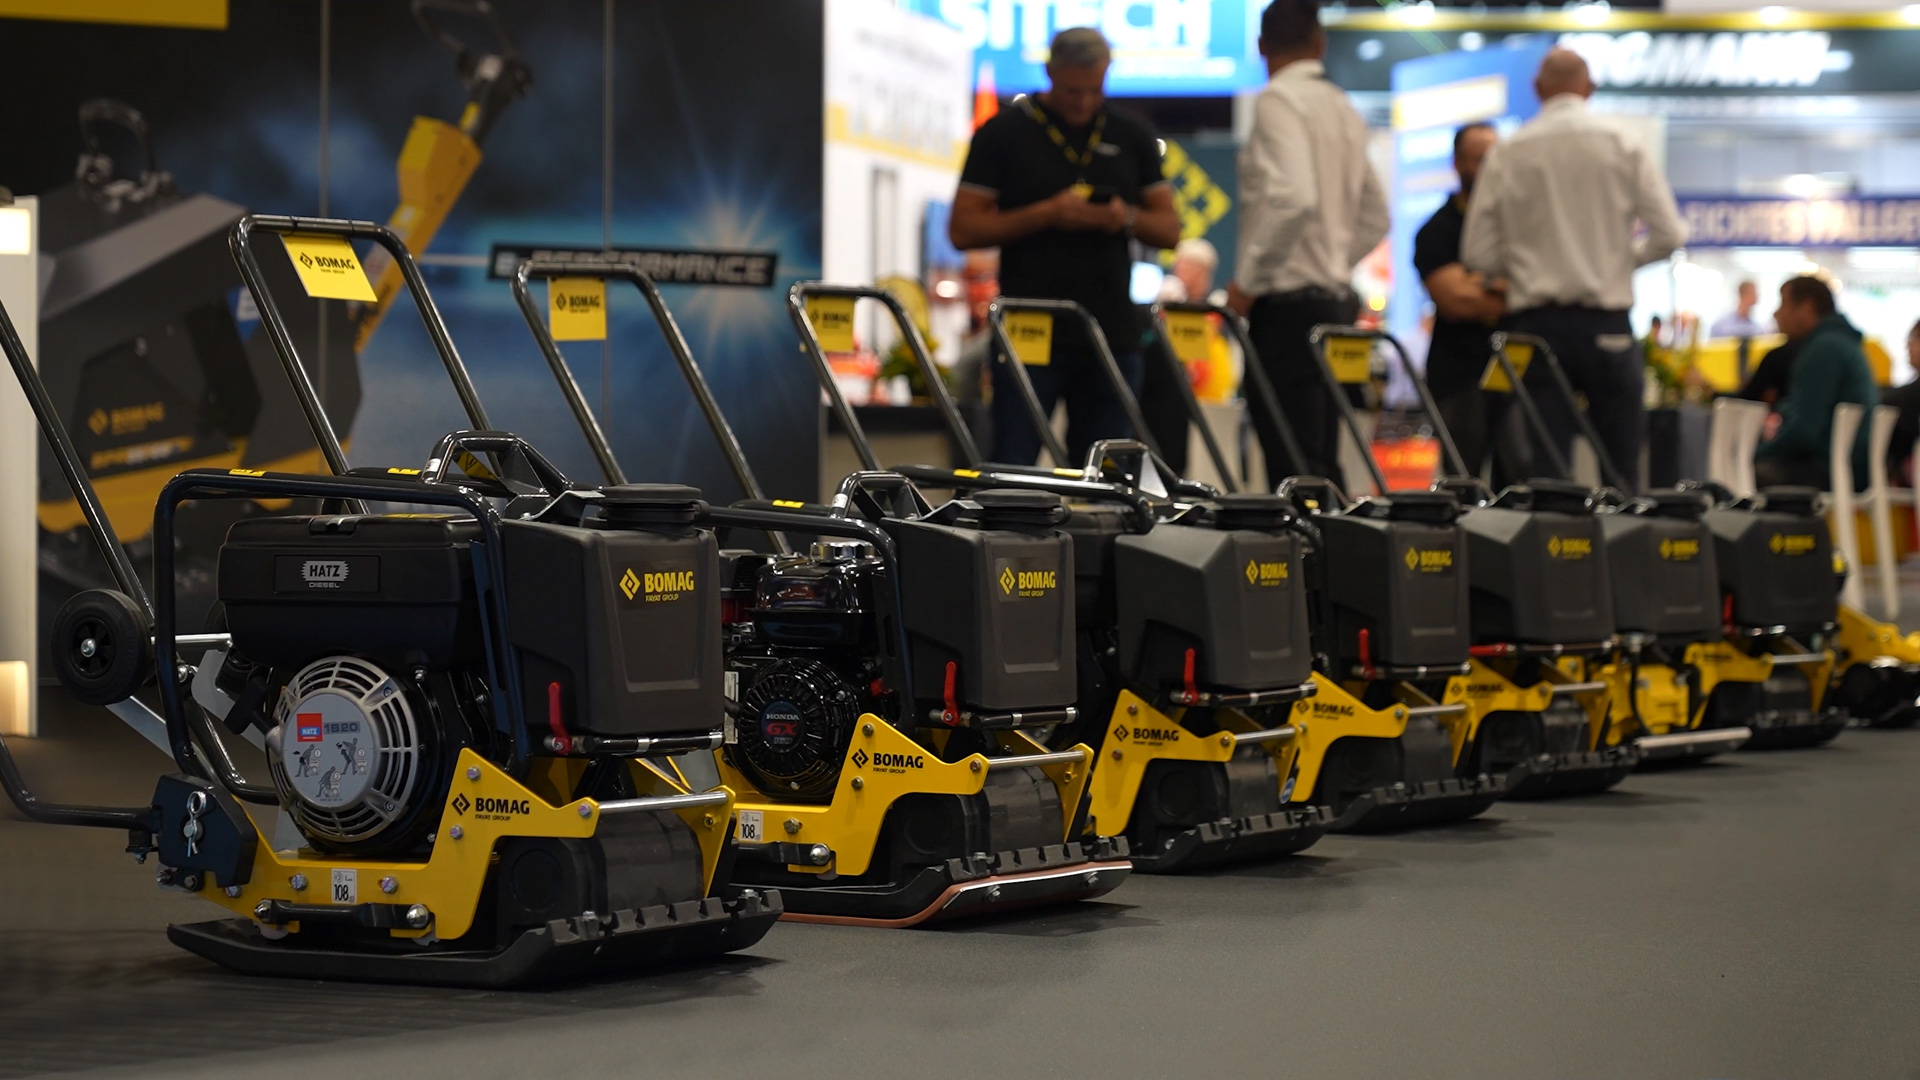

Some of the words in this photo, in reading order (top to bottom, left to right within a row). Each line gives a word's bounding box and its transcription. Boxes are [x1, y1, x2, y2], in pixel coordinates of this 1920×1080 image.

[314, 256, 355, 270] BOMAG
[569, 295, 600, 308] BOMAG
[309, 565, 340, 577] HATZ
[1260, 563, 1288, 579] BOMAG
[644, 571, 695, 593] BOMAG
[1018, 571, 1056, 589] BOMAG
[645, 594, 661, 602] FAYAT
[662, 593, 680, 601] GROUP
[1313, 702, 1354, 717] BOMAG
[302, 727, 318, 735] HATZ
[324, 722, 358, 733] 1B20
[766, 722, 798, 736] GX
[1133, 728, 1179, 742] BOMAG
[873, 752, 924, 769] BOMAG
[475, 798, 530, 815] BOMAG
[741, 823, 756, 839] 108
[333, 883, 349, 901] 108
